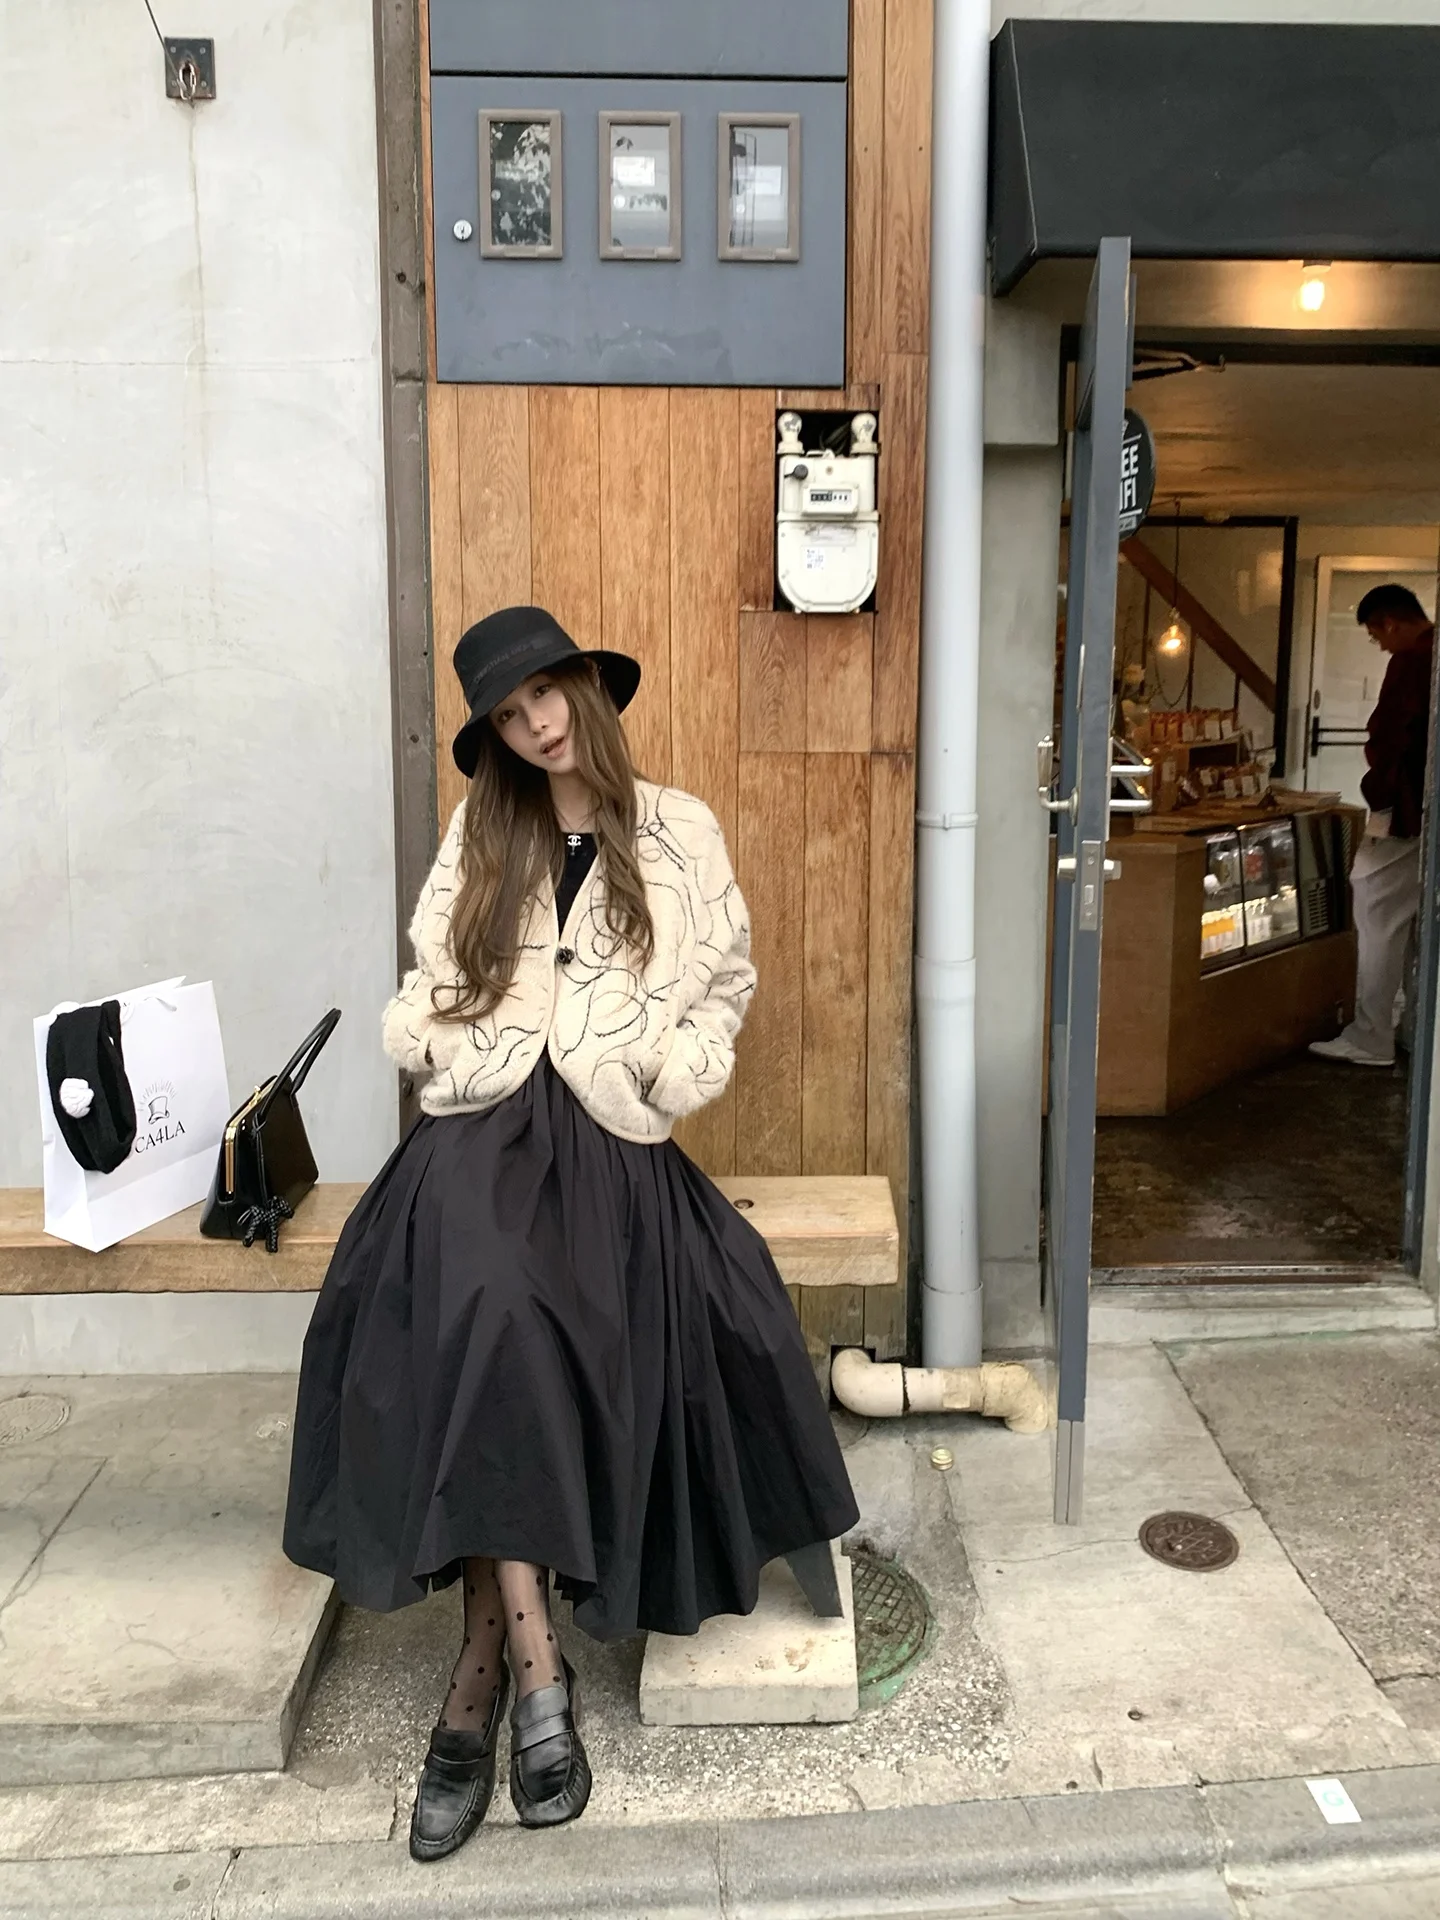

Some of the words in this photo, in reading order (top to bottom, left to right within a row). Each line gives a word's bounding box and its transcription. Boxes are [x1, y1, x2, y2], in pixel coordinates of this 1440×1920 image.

[1121, 444, 1139, 478] EE
[1119, 477, 1137, 511] IFI
[135, 1120, 186, 1154] CA4LA
